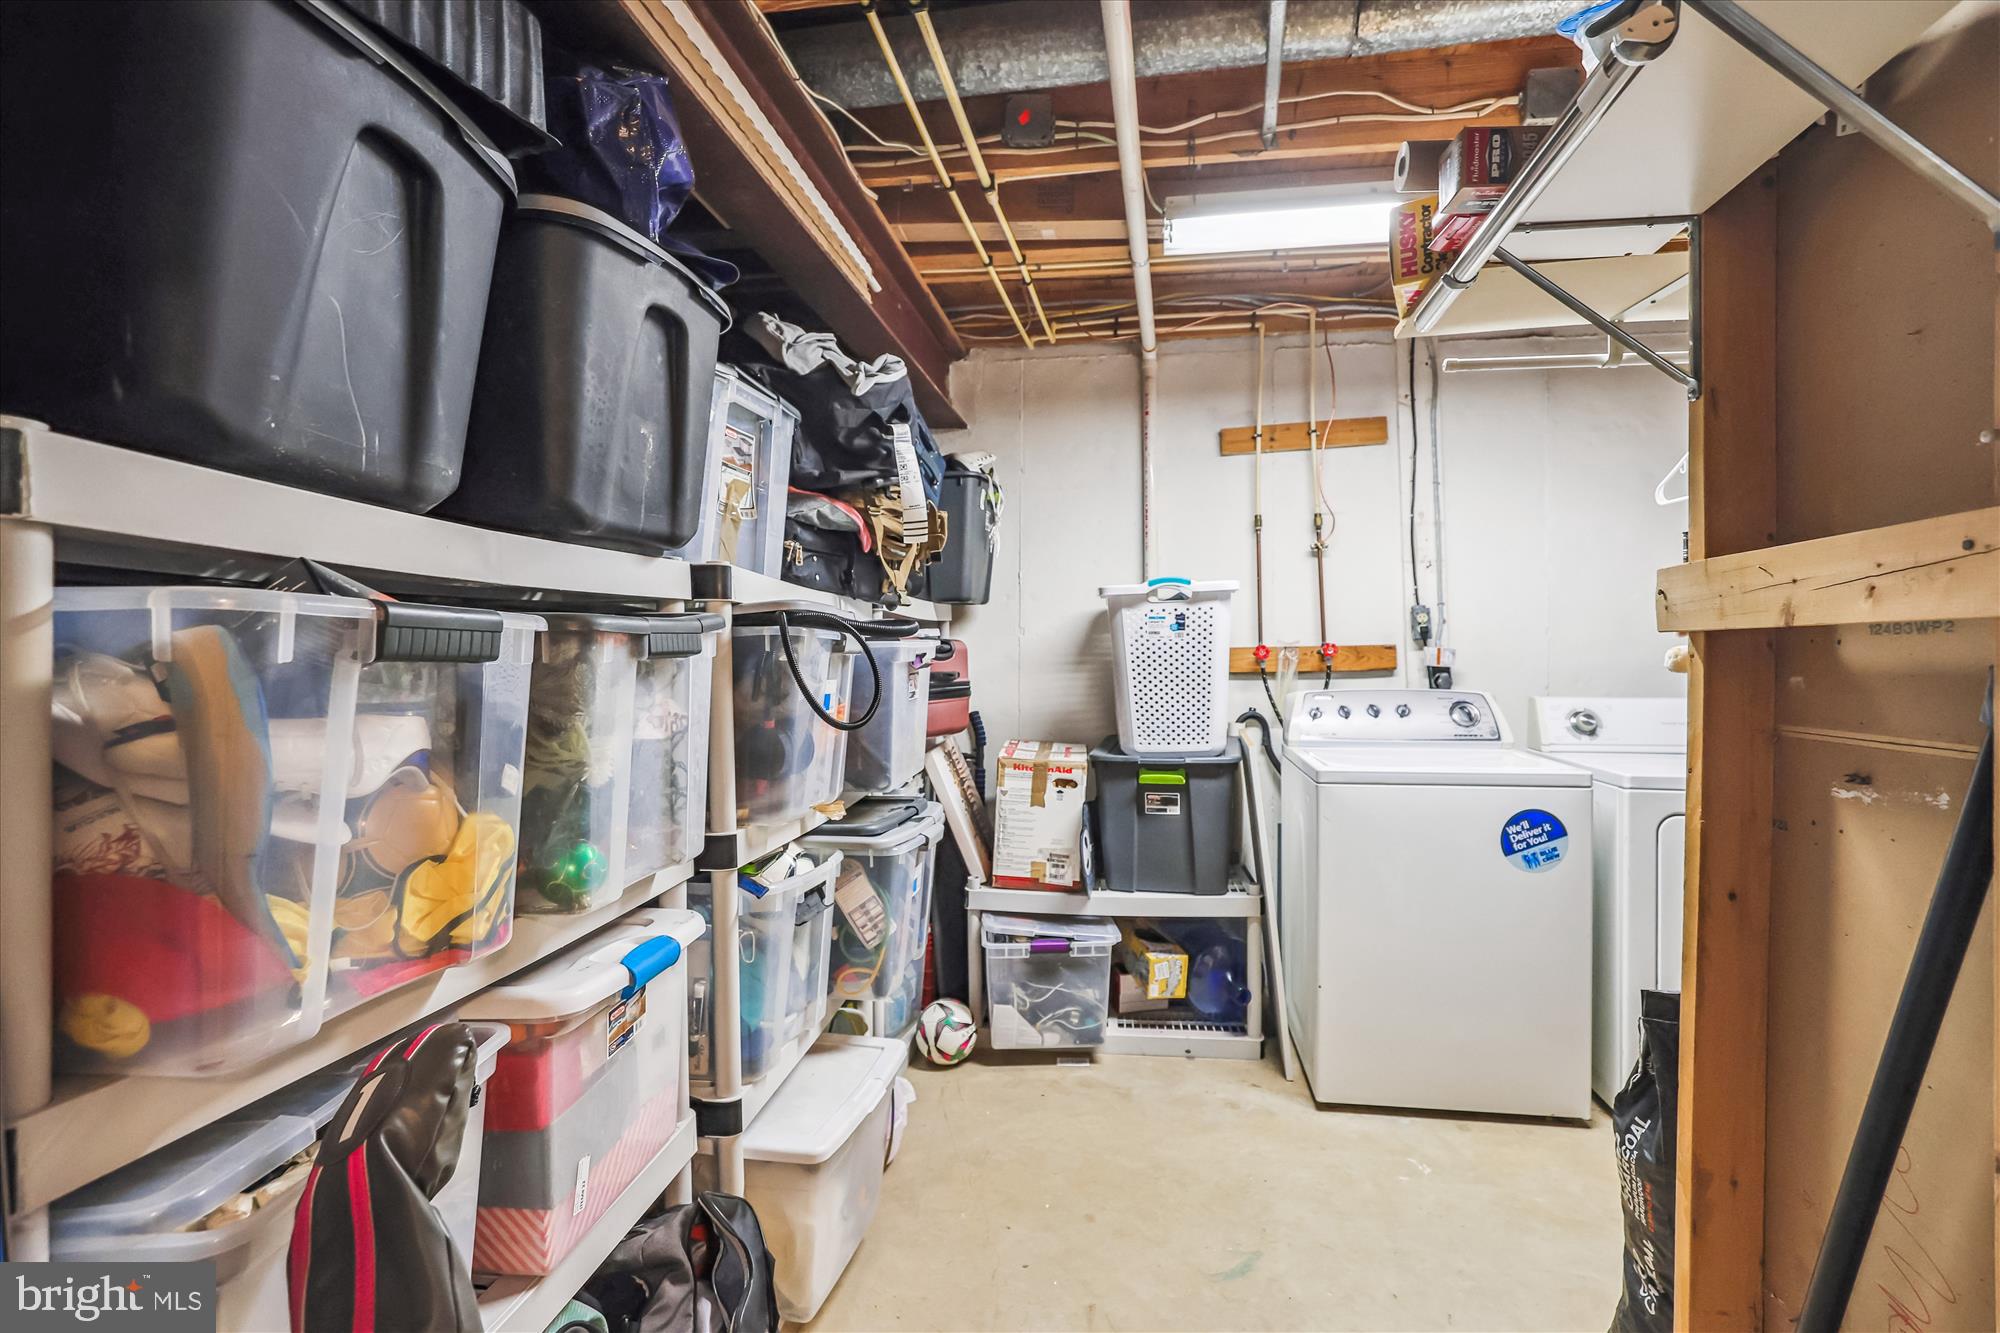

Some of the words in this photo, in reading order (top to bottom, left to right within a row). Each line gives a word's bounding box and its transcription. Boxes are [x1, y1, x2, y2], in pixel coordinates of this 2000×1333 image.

[1472, 132, 1480, 182] Fluidmaster
[1491, 134, 1501, 178] PRO
[1400, 212, 1418, 278] HUSKY
[1421, 204, 1434, 274] Contractor
[1013, 763, 1073, 774] KitcnAid
[1506, 820, 1530, 835] We'll
[1510, 826, 1543, 843] Deliver
[1542, 823, 1552, 832] it
[1513, 841, 1527, 851] for
[1527, 833, 1549, 846] You!
